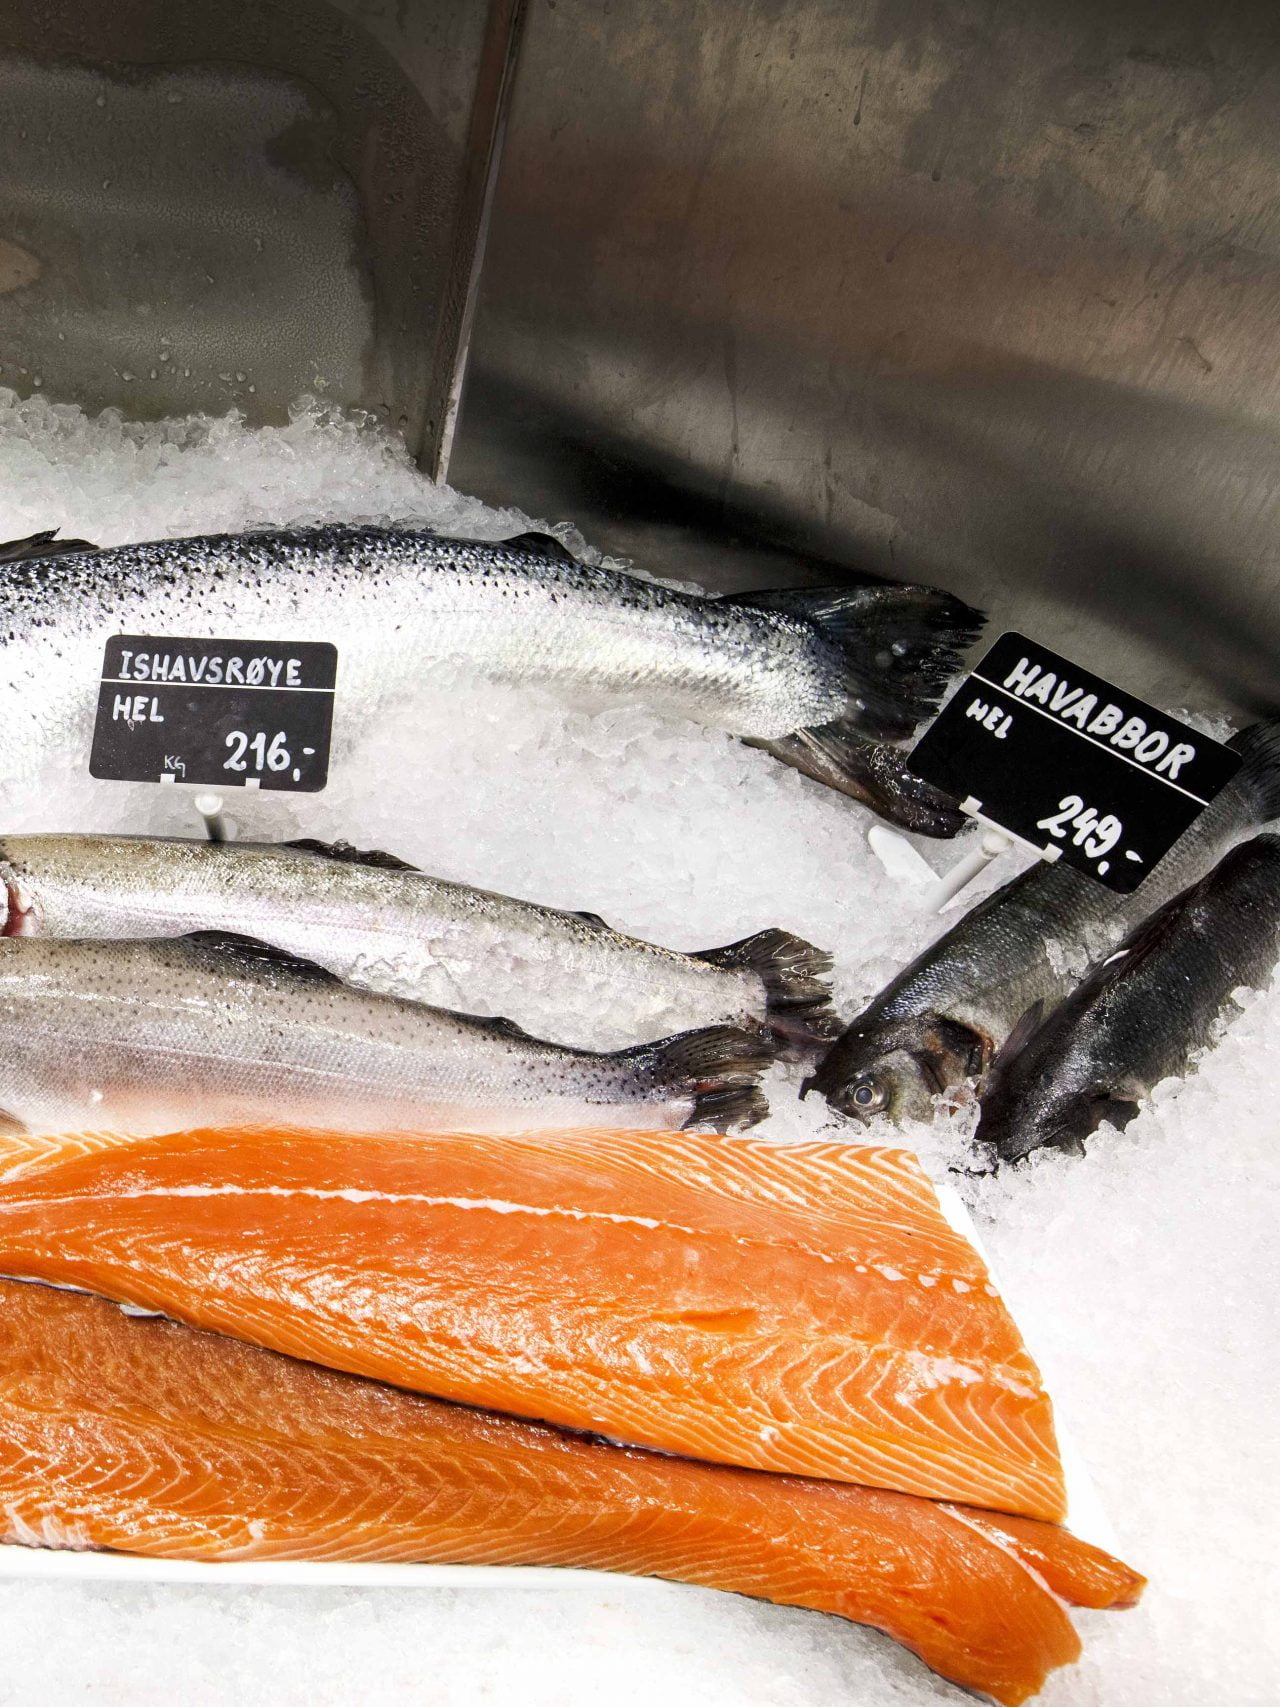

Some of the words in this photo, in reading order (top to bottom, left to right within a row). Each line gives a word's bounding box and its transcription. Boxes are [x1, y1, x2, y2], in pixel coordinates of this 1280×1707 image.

[119, 651, 302, 687] ISHAVSRØYE
[112, 694, 165, 723] HEL
[966, 698, 1014, 739] HEL
[1003, 657, 1196, 780] HAVABBOR
